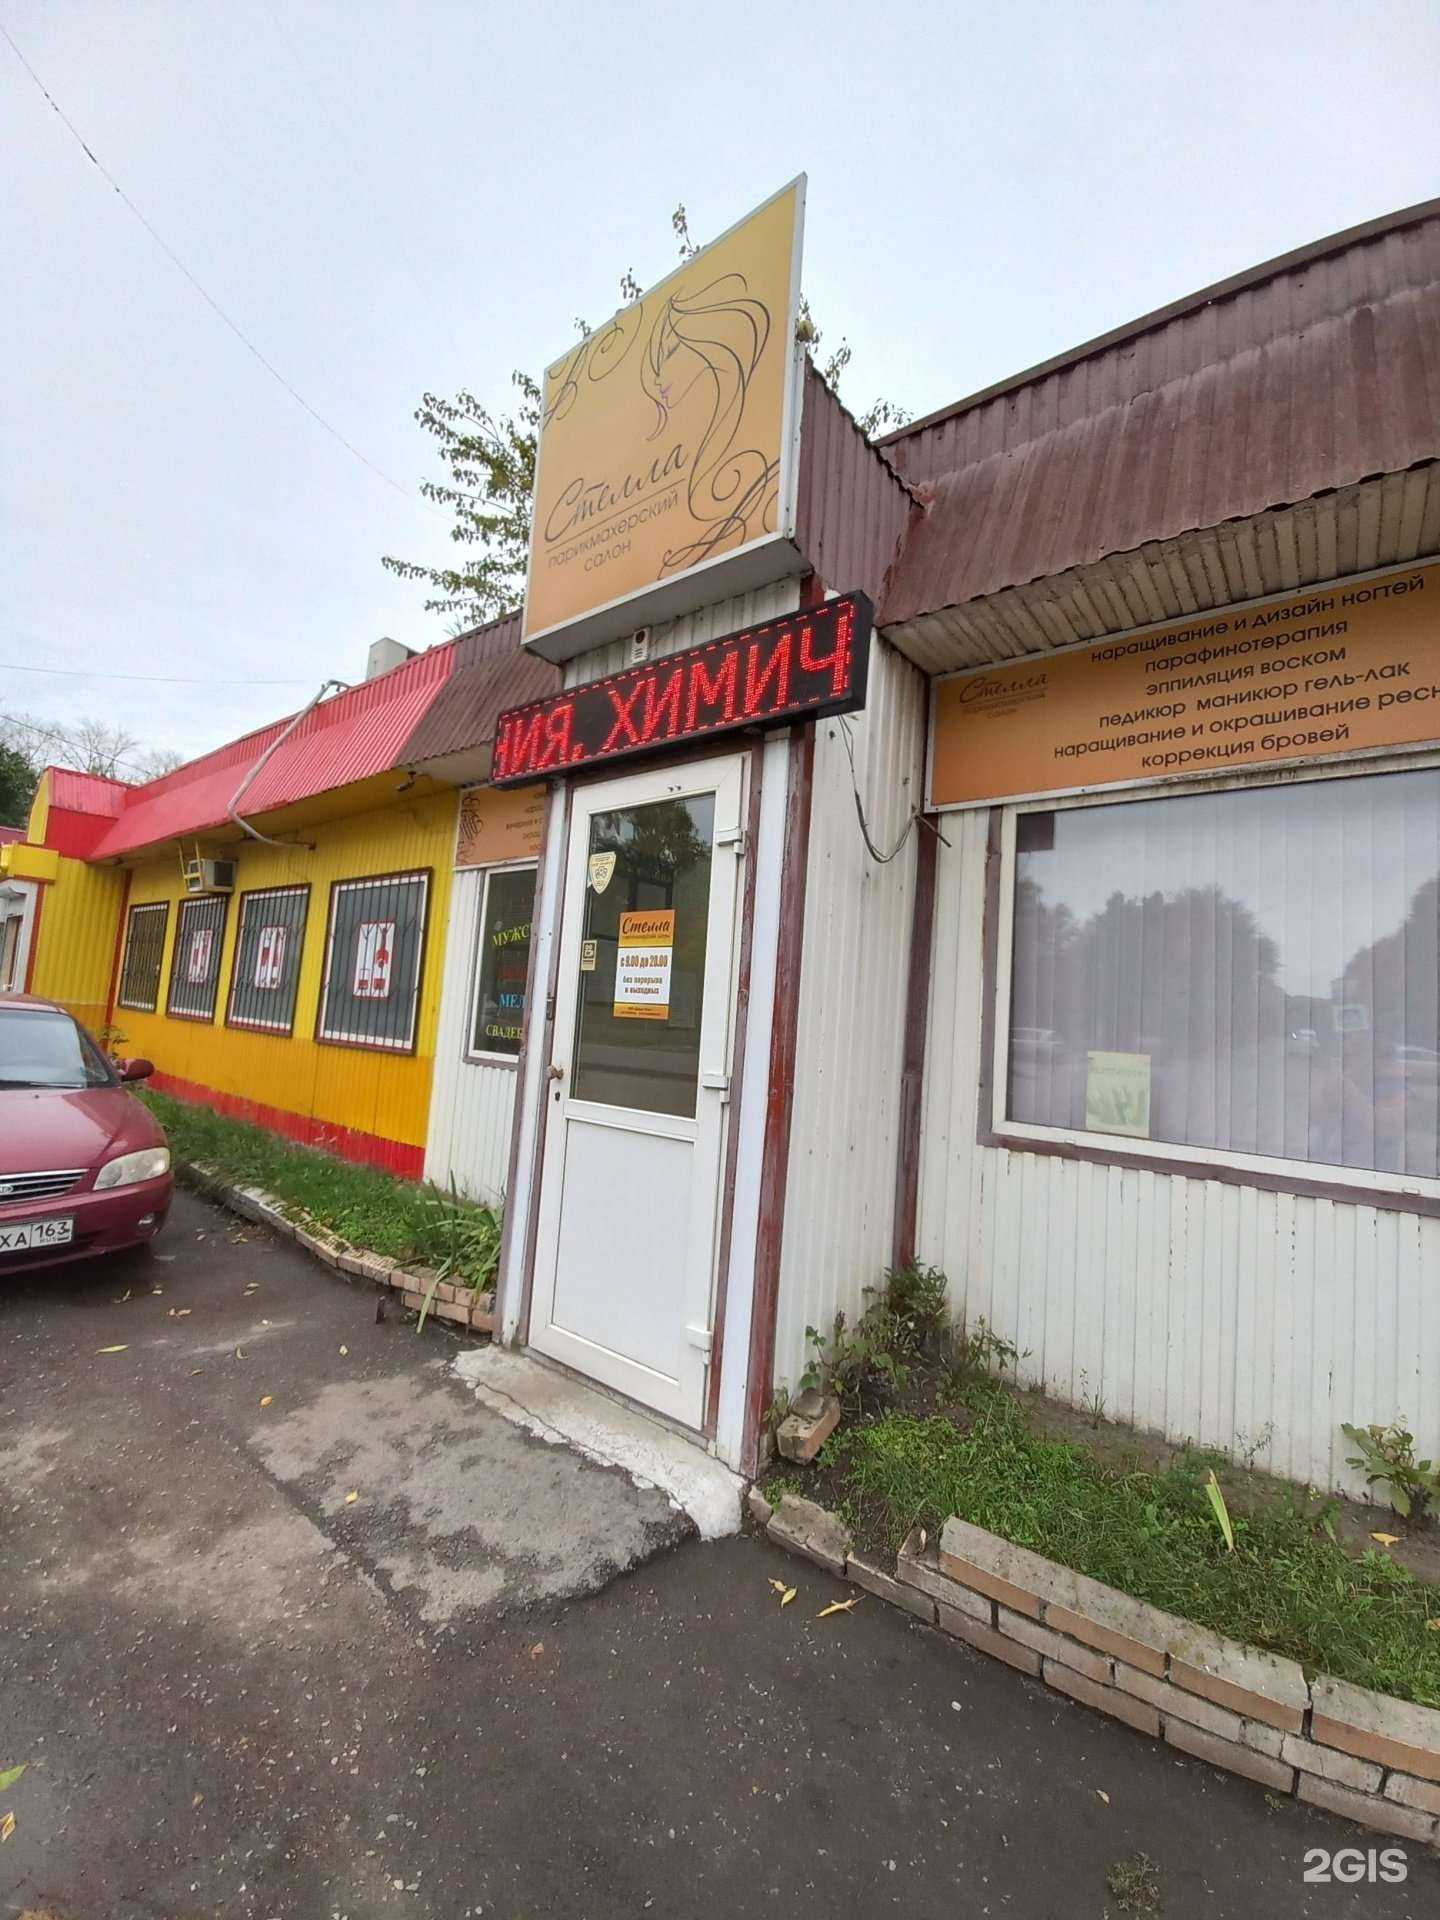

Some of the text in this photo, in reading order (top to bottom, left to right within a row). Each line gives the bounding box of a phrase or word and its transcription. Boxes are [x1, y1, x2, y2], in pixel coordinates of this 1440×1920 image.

[545, 444, 688, 542] Стелла
[549, 488, 678, 568] парикмахерский
[584, 540, 632, 571] салон
[1092, 575, 1425, 662] наращивание и дизайн ногтей
[1145, 620, 1348, 673] парафинотерапия
[602, 614, 849, 751] ХИМИЧ
[1099, 662, 1411, 728] педикюр маникюр гель-лак
[1146, 648, 1346, 696] эппиляция воском
[1054, 727, 1186, 759] наращивание
[1191, 724, 1204, 737] и
[1209, 697, 1370, 732] окрашивание
[1142, 723, 1350, 768] коррекция бровей
[622, 916, 671, 934] Стелла
[35, 1222, 67, 1238] 163
